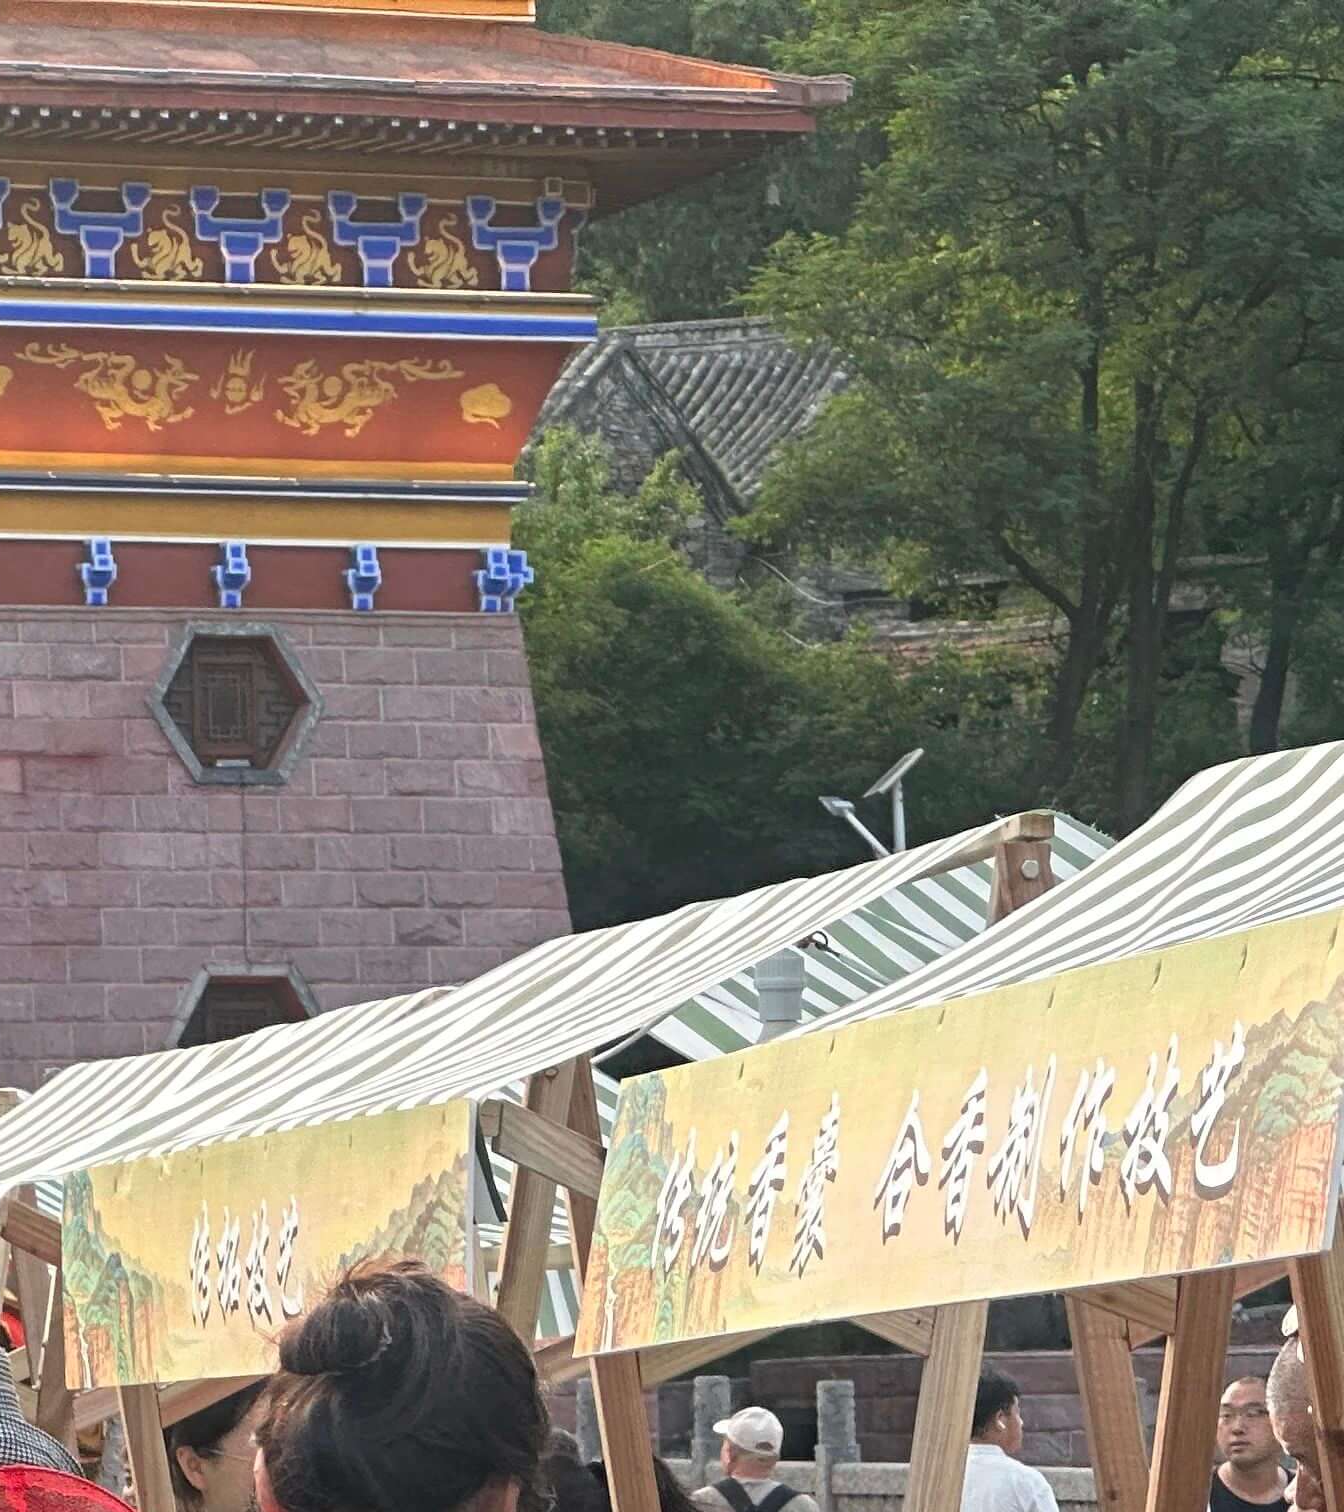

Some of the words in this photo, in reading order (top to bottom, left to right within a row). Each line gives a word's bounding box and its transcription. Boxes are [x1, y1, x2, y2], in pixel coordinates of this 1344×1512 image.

[873, 1018, 1247, 1246] 合香制作技艺
